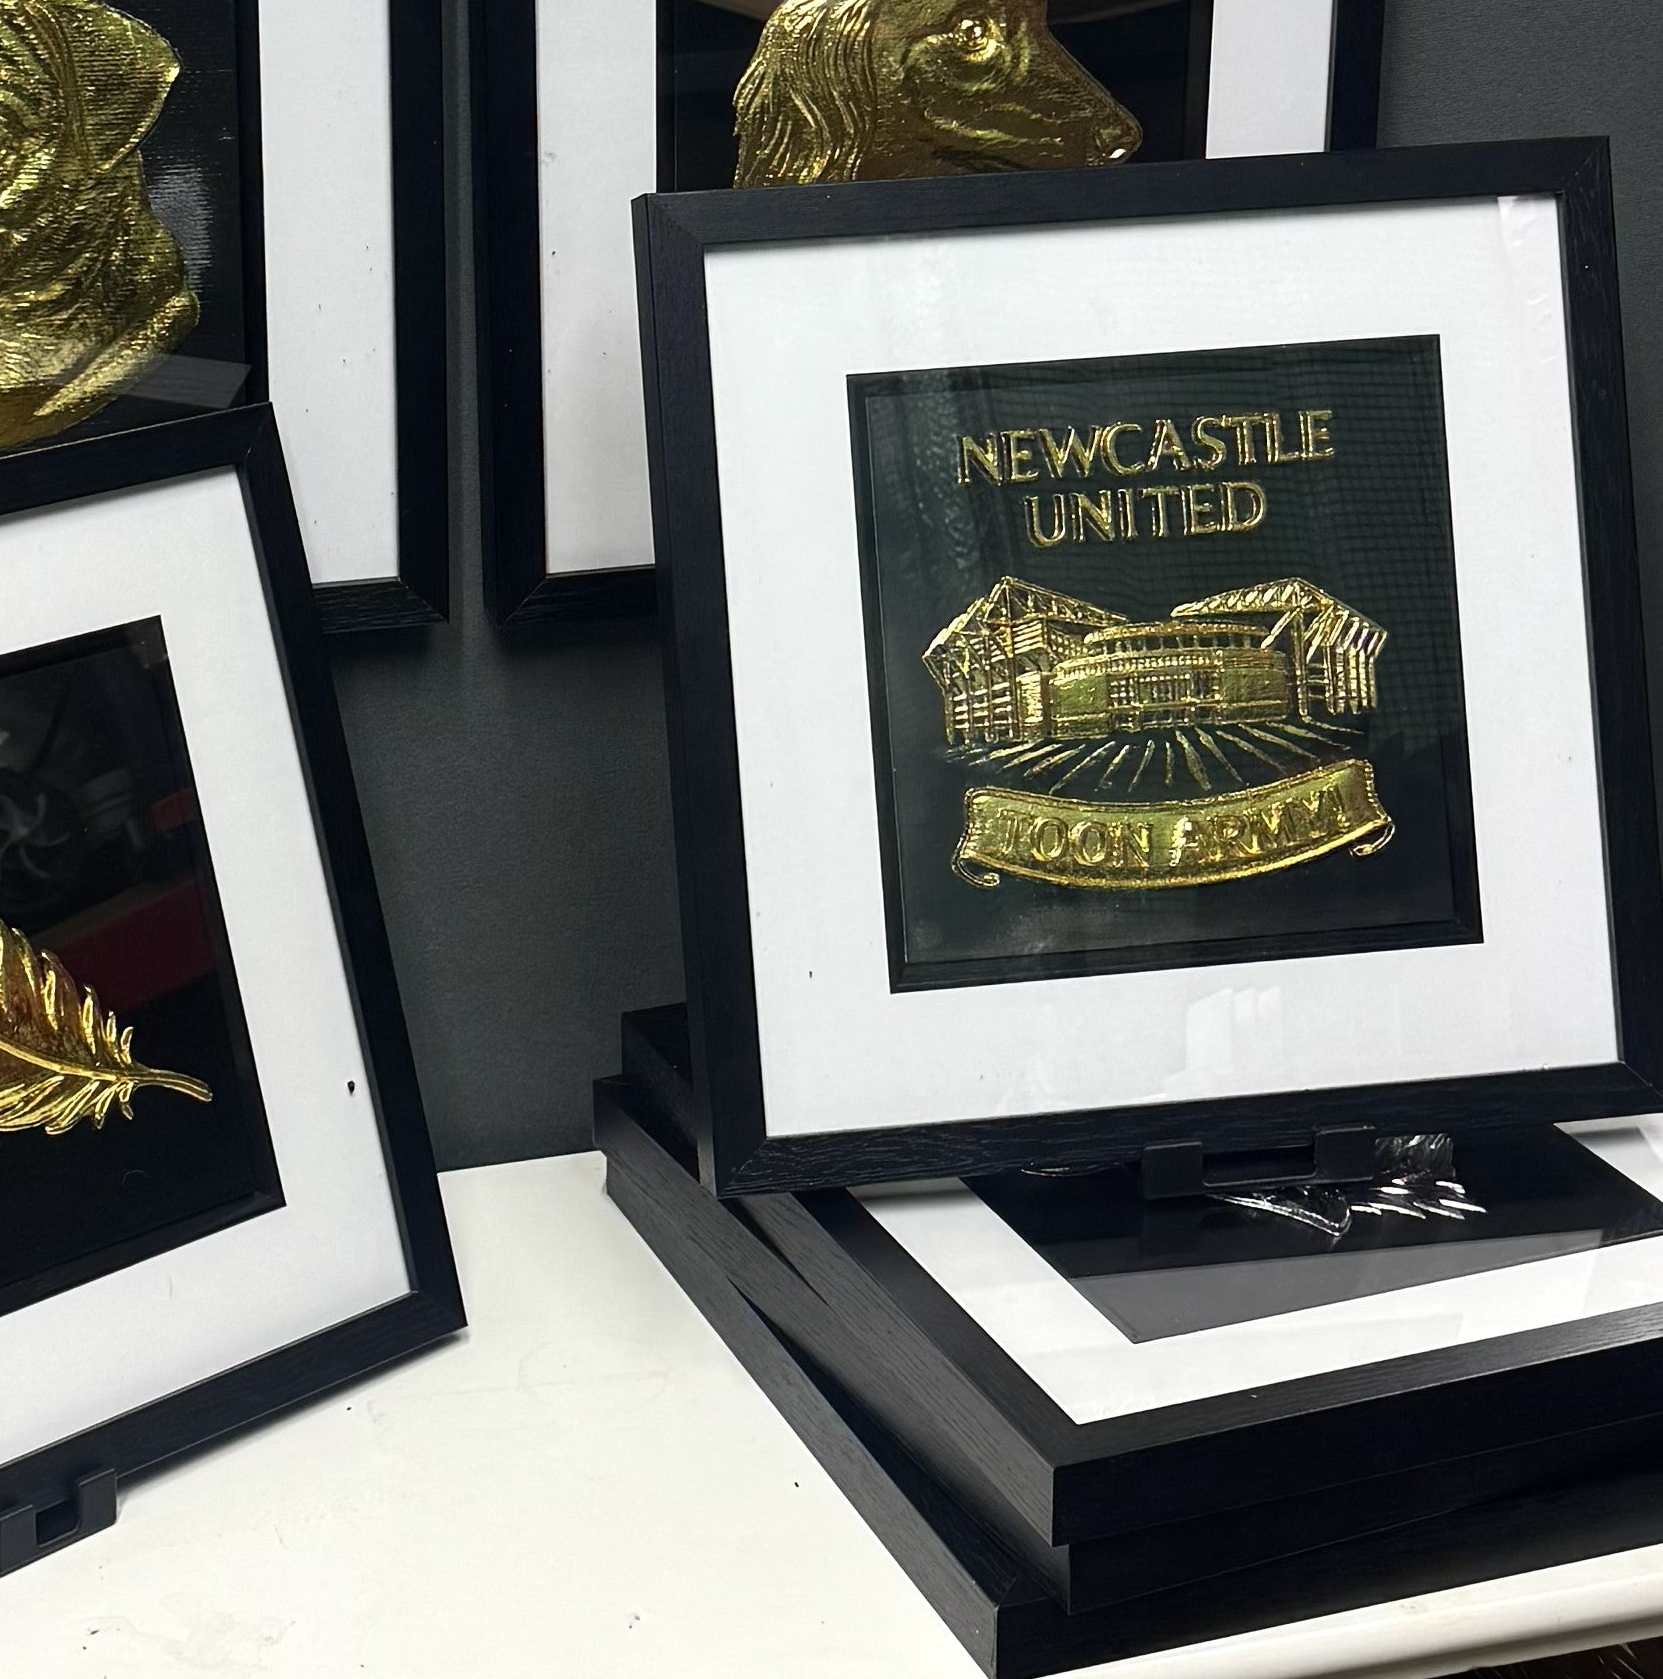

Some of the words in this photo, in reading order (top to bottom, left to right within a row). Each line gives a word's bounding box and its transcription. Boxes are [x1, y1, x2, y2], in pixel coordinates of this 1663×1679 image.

[956, 409, 1335, 485] NEWCASTLE
[1023, 482, 1267, 548] UNITED
[998, 808, 1152, 868] TOON
[1168, 784, 1351, 867] ARMY!
